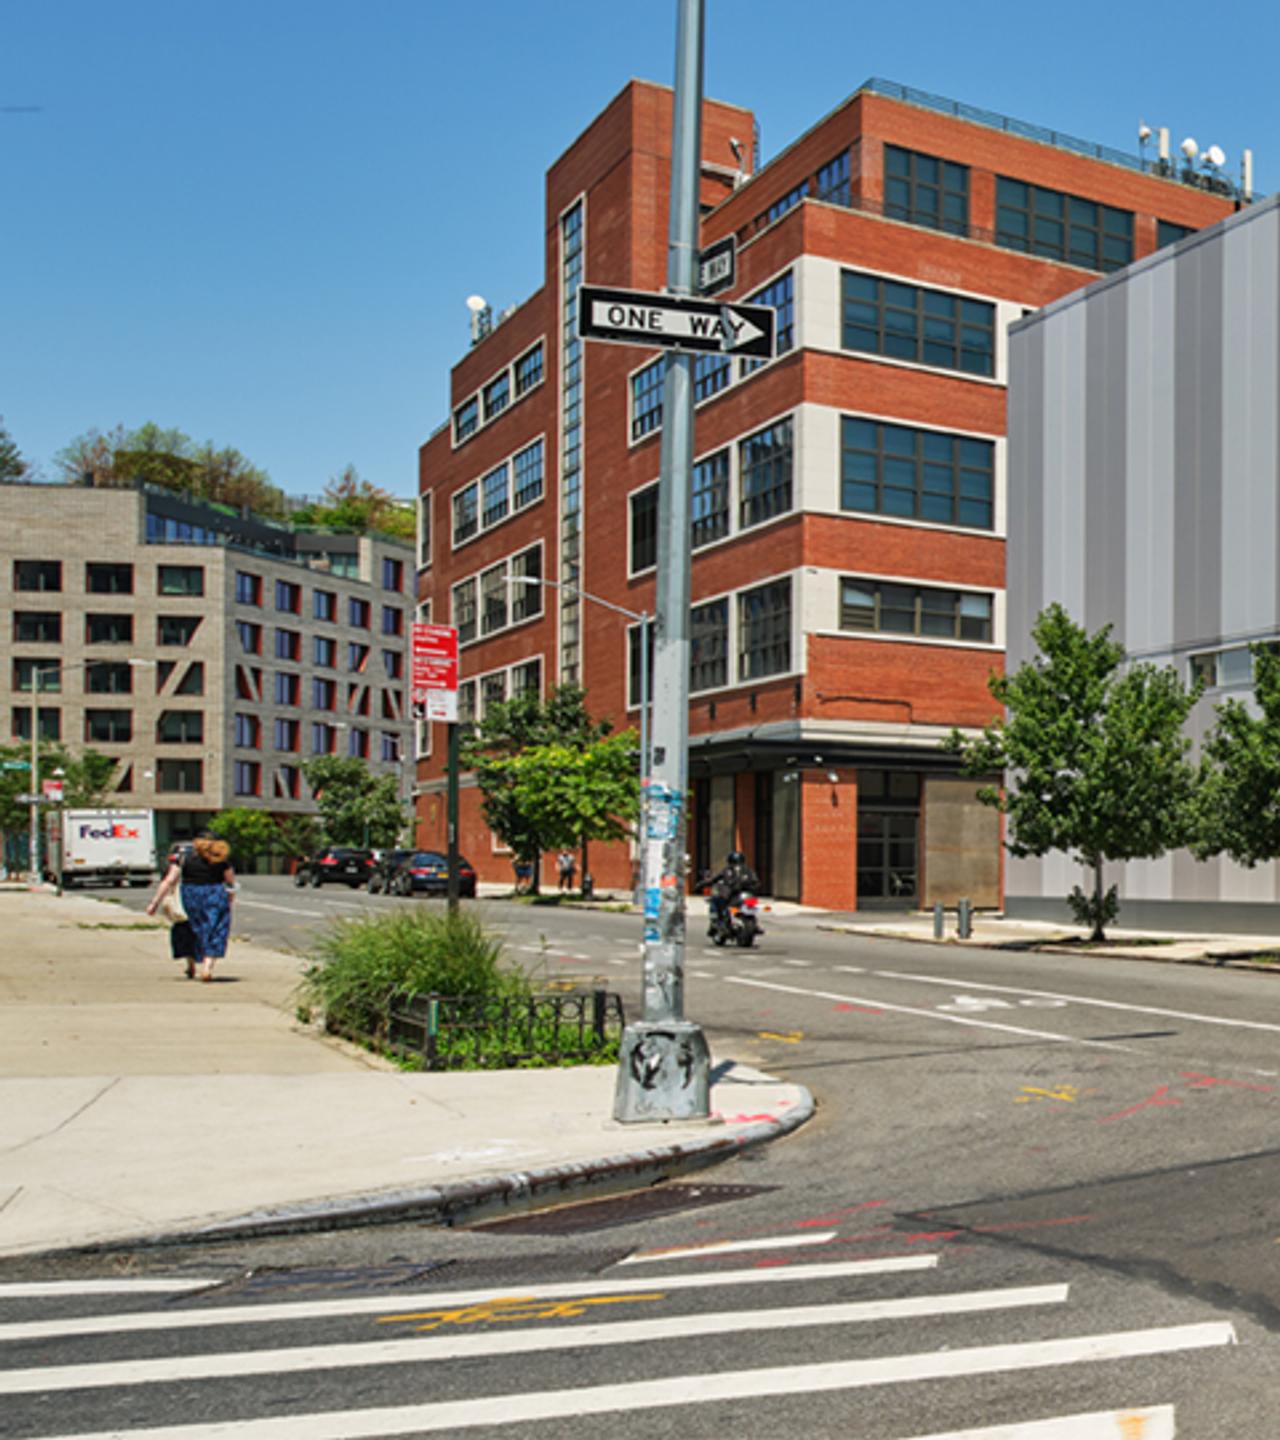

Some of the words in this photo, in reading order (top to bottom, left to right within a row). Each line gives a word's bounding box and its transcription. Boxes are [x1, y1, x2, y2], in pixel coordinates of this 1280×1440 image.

[607, 304, 664, 331] ONE
[689, 315, 746, 340] WAY
[79, 821, 139, 839] FedEx
